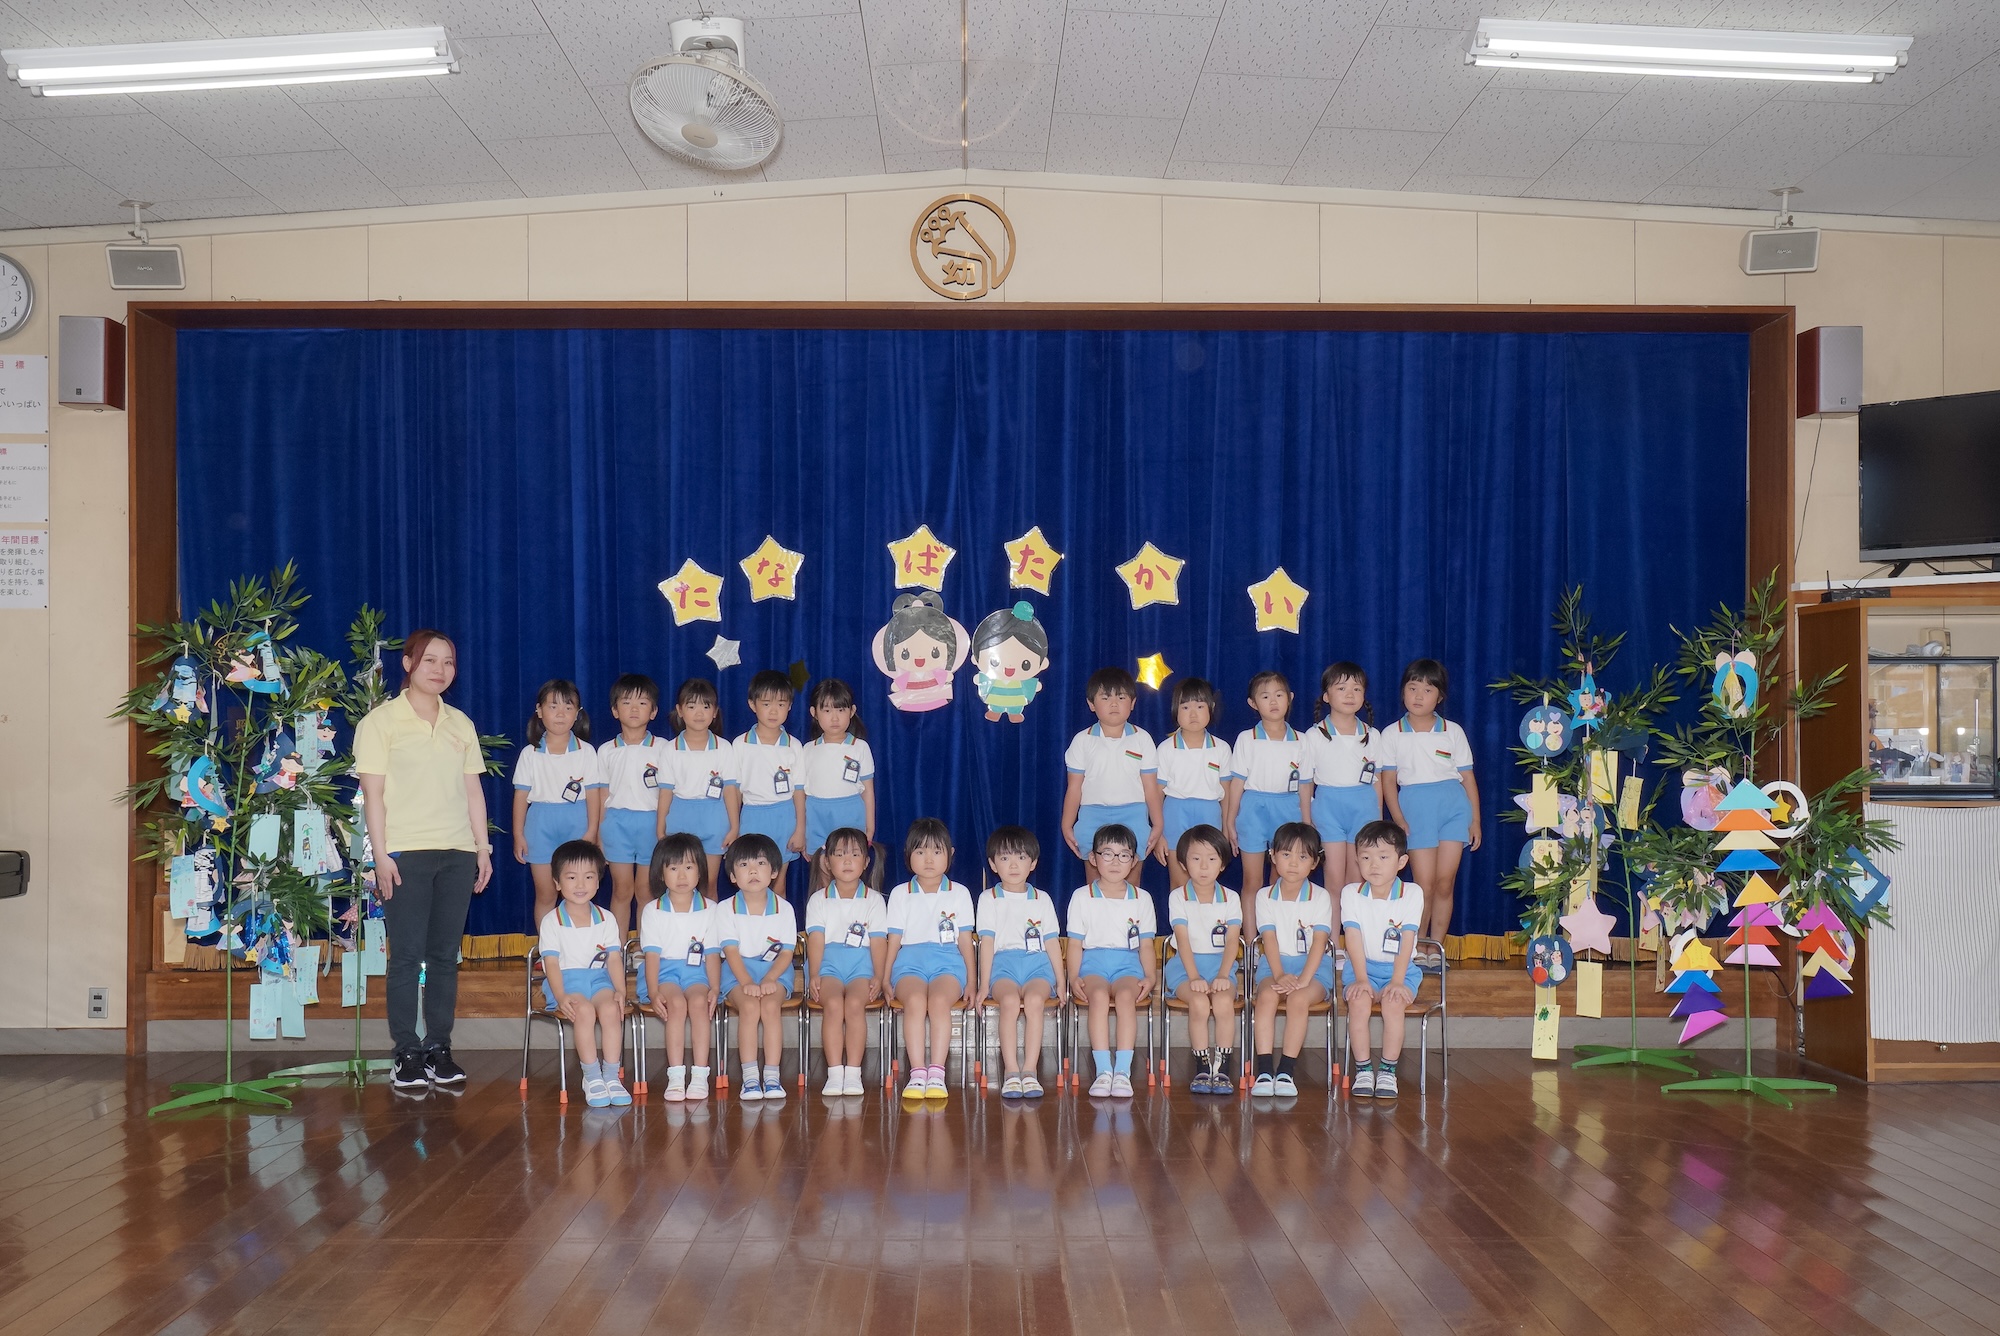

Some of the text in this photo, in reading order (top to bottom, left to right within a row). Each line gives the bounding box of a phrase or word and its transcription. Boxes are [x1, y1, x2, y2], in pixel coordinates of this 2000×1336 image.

[942, 260, 976, 285] 幼
[11, 275, 18, 286] 2
[15, 291, 22, 302] 3
[11, 306, 18, 317] 4
[1, 317, 7, 328] 5
[674, 543, 1295, 615] た な ば た か い
